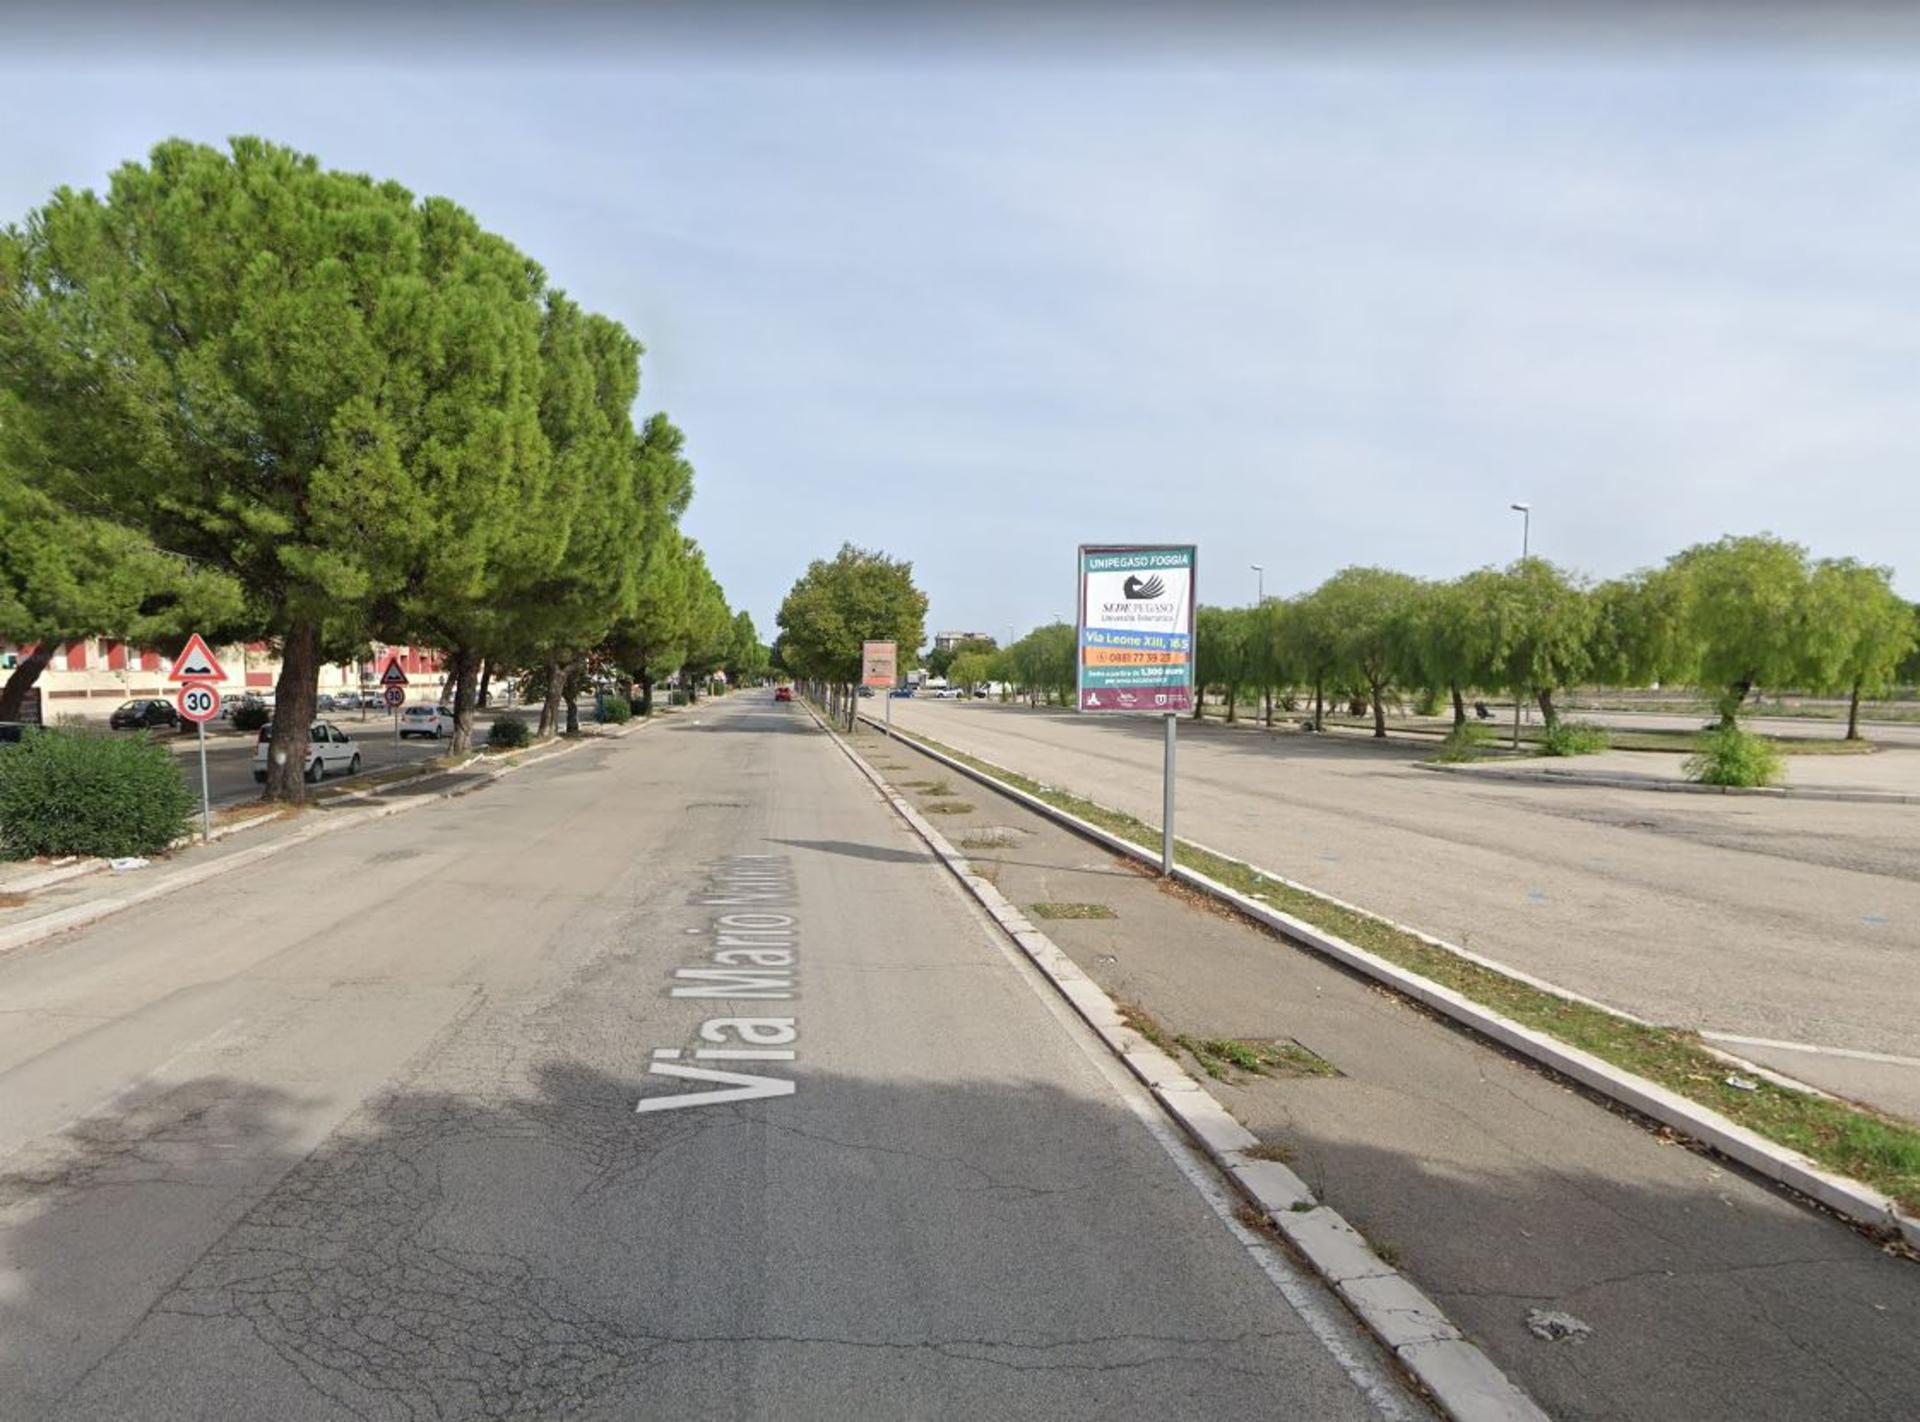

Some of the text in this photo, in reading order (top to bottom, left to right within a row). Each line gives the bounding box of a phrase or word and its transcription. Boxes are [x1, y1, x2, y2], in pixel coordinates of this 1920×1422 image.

[1089, 554, 1189, 570] UNIPEGASO FOGGIA
[1086, 631, 1104, 643] Via
[1106, 633, 1141, 646] Leone
[187, 692, 212, 711] 30
